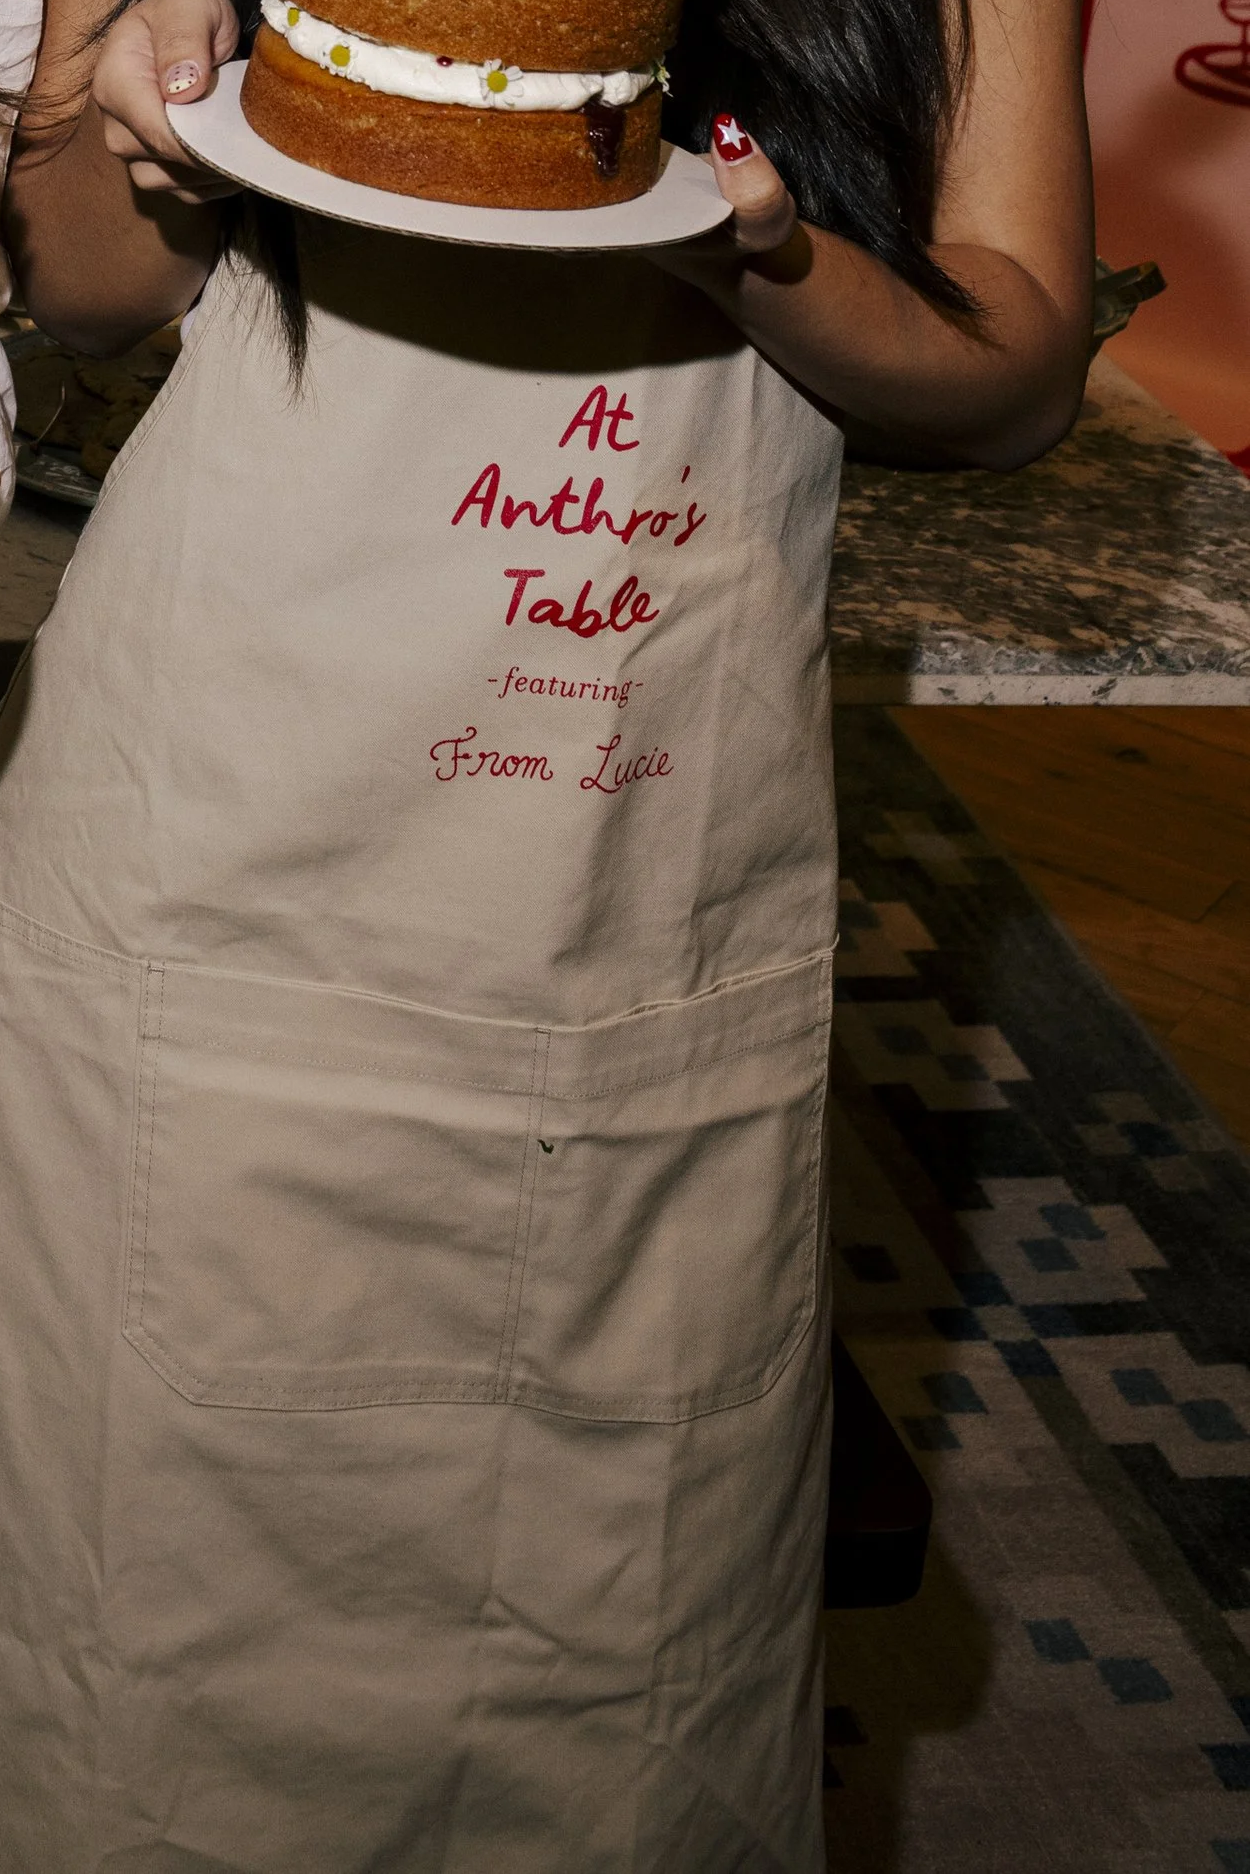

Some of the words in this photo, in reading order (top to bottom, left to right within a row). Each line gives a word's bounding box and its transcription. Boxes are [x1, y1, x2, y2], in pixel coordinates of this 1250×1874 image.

[558, 384, 640, 452] At
[451, 462, 708, 547] Anthro's
[503, 568, 660, 639] Table
[429, 726, 554, 782] From
[579, 733, 675, 794] Lucie
